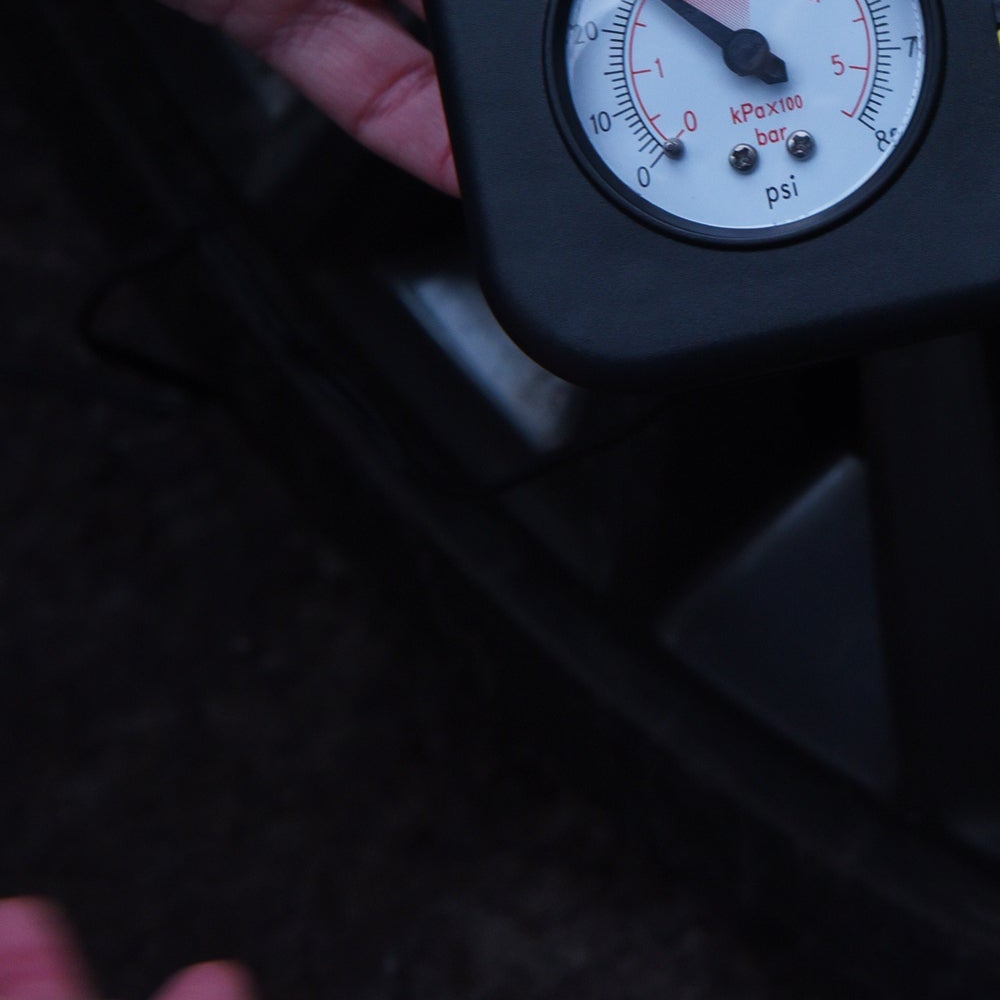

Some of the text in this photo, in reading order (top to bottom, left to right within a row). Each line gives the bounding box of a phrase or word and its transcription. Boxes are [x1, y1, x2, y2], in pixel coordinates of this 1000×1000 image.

[570, 21, 599, 45] 20
[654, 57, 664, 79] 1
[831, 54, 845, 76] 5
[590, 110, 612, 135] 10
[683, 110, 698, 132] 0
[754, 126, 788, 146] bar
[637, 166, 650, 188] 0
[765, 174, 799, 210] psi
